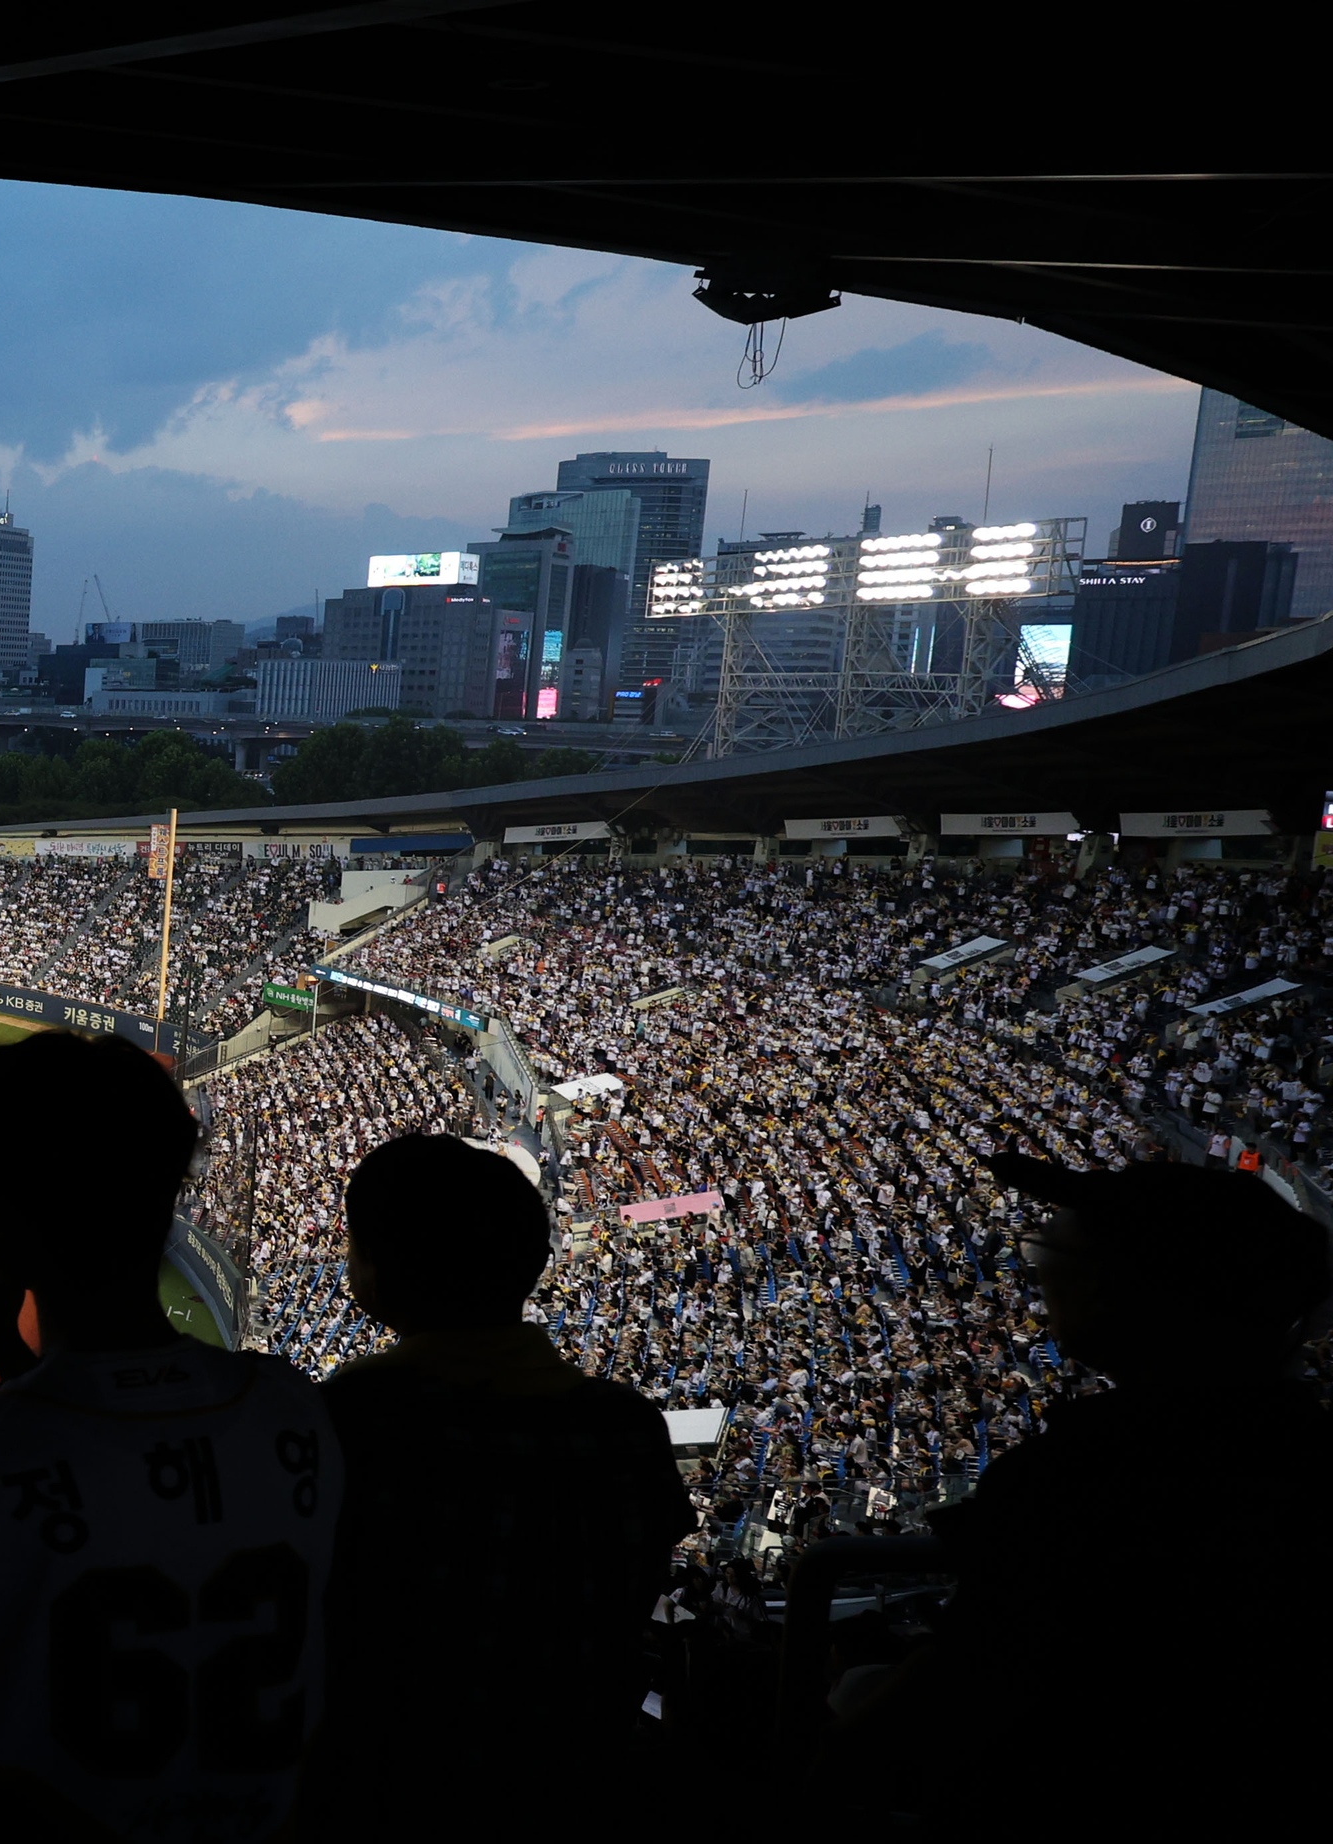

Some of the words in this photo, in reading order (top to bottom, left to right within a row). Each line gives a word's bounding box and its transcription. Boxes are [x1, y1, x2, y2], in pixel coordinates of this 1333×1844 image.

[1120, 577, 1145, 585] STAY
[275, 991, 290, 1001] NH
[6, 995, 24, 1009] KB
[25, 999, 44, 1014] 증권
[64, 1007, 116, 1033] 키움증권
[138, 1021, 154, 1033] 100m
[2, 1430, 320, 1555] 정해영
